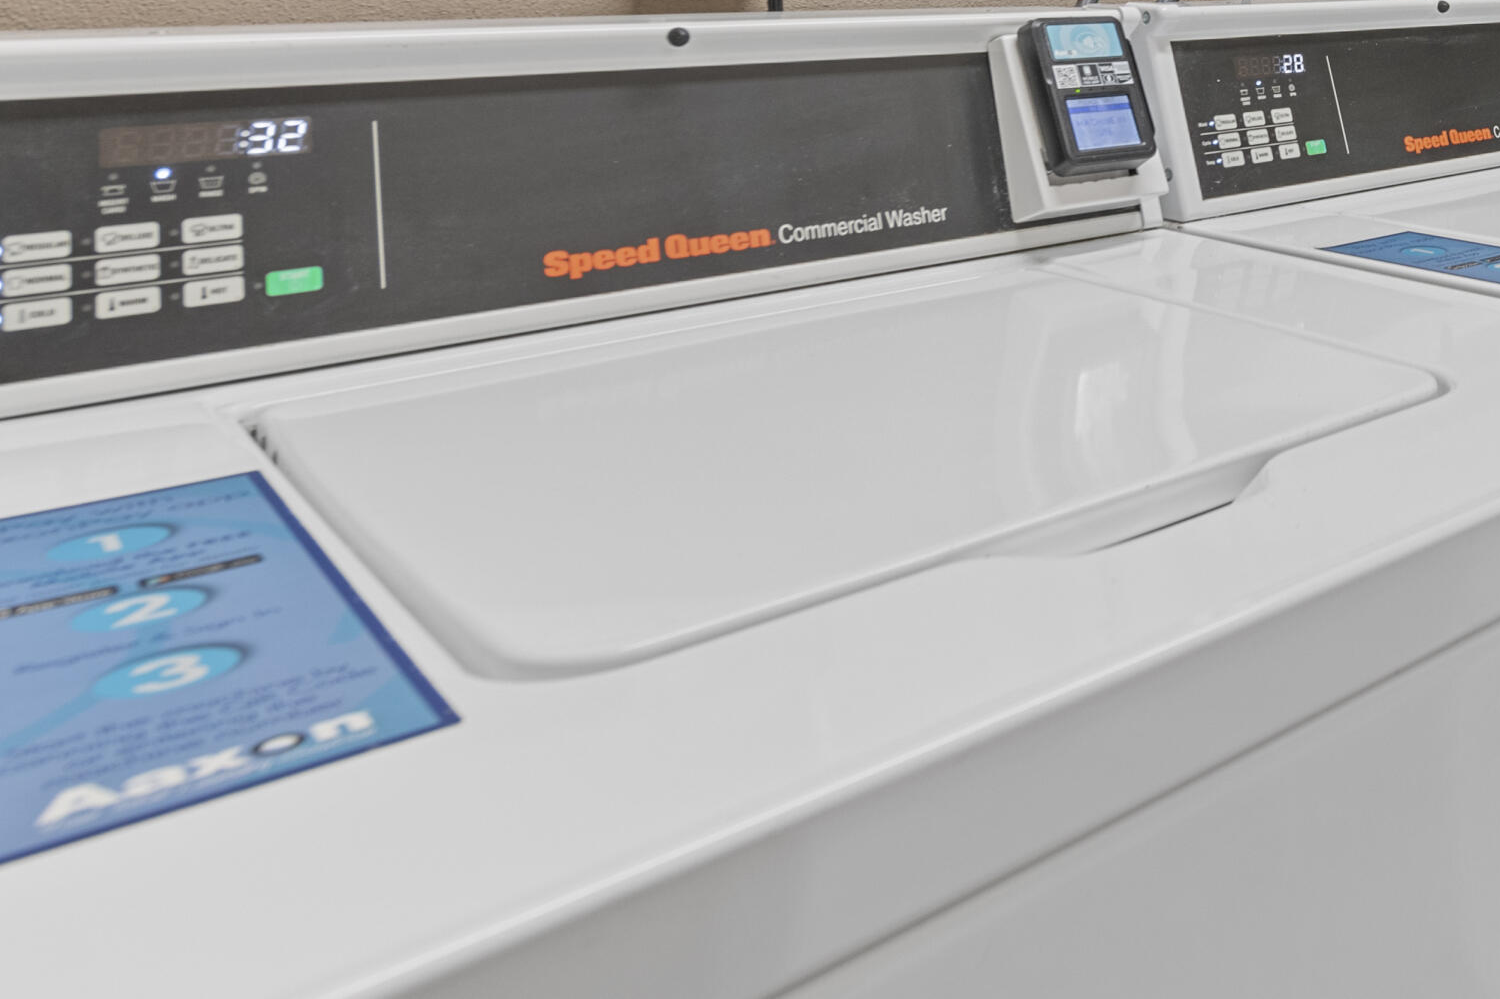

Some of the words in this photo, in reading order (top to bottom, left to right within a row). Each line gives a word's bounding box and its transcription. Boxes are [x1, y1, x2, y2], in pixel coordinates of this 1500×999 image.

[1404, 130, 1449, 154] Speed
[1450, 128, 1493, 145] Queen
[543, 236, 661, 280] Speed
[665, 226, 776, 260] Queen
[778, 211, 883, 245] Commercial
[886, 204, 948, 228] Washer
[85, 532, 124, 553] 1
[104, 592, 179, 628] 2
[129, 653, 210, 694] 3
[34, 708, 376, 827] Aaxon
